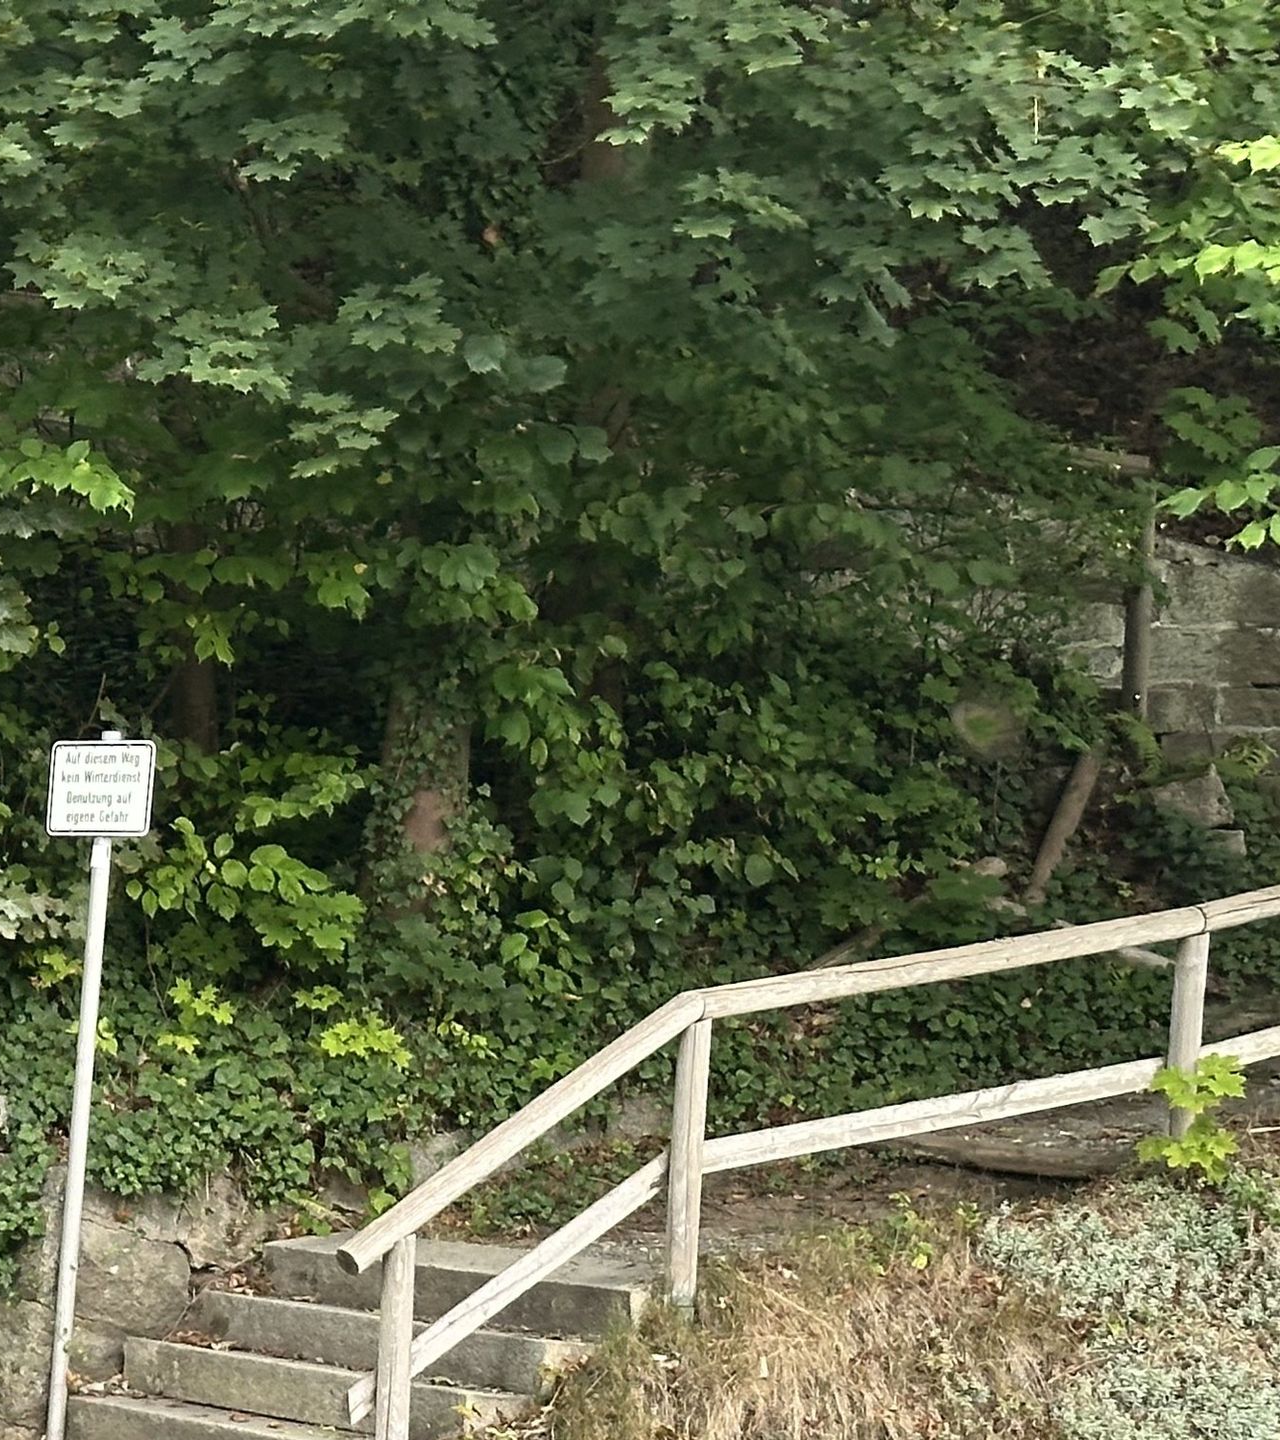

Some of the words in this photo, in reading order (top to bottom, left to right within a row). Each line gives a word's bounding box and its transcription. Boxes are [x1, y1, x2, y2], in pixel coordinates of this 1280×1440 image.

[65, 751, 81, 764] Auf
[84, 752, 117, 764] diesem
[121, 752, 140, 767] Weg
[61, 771, 80, 783] kein
[84, 771, 141, 783] Winterdienst
[66, 791, 113, 807] Benutzung
[116, 791, 132, 804] auf
[66, 812, 95, 825] eigene
[99, 810, 129, 823] Gefahr
